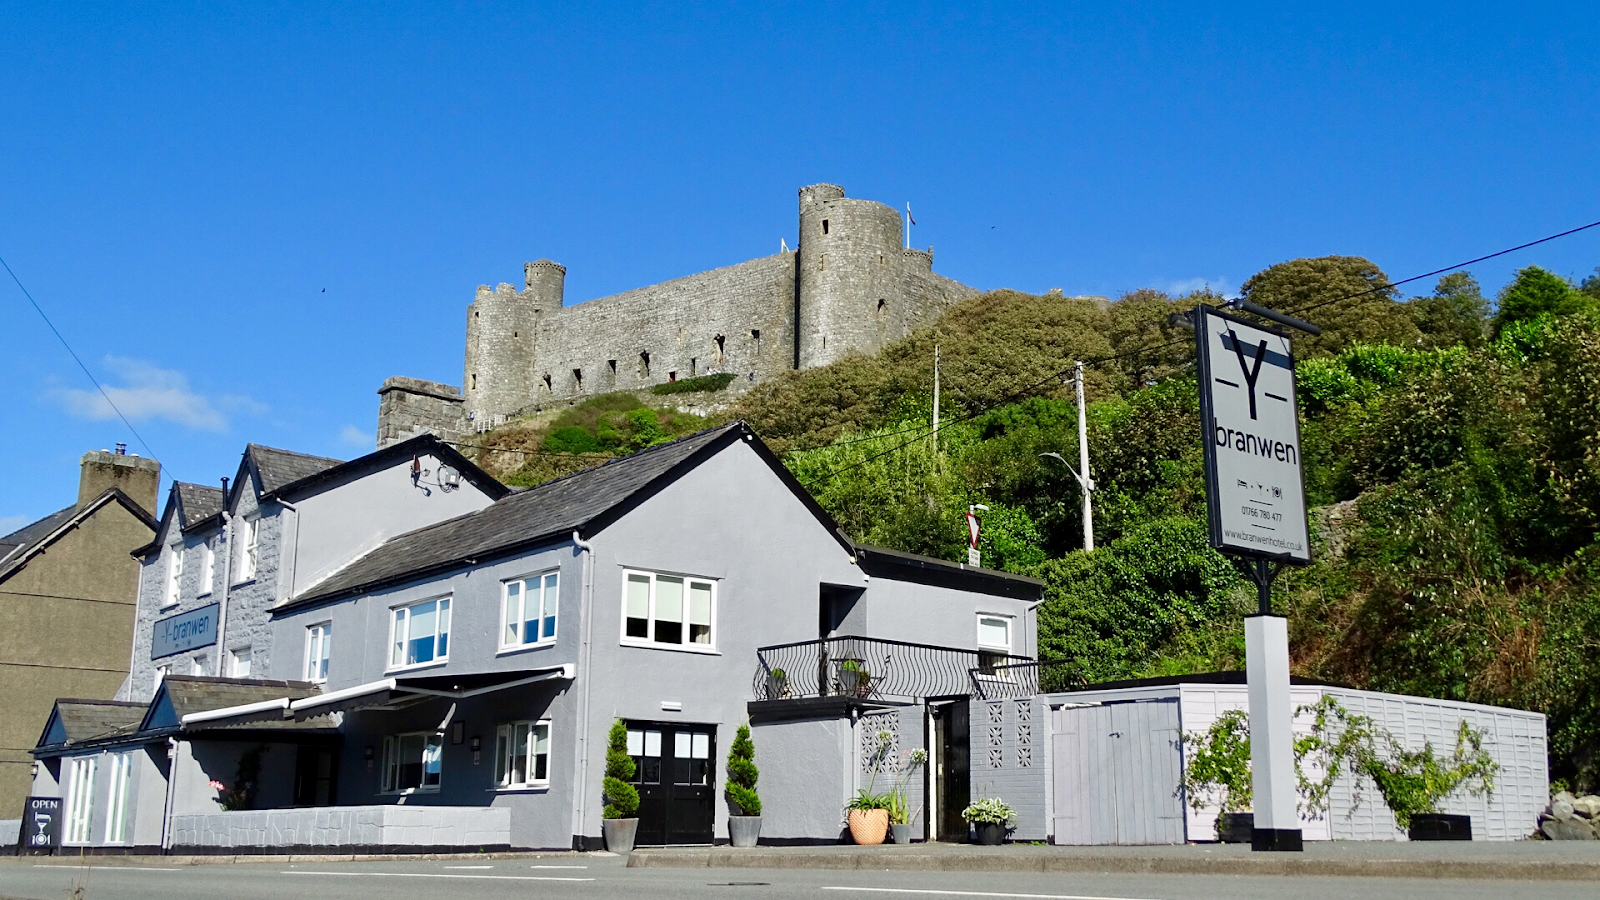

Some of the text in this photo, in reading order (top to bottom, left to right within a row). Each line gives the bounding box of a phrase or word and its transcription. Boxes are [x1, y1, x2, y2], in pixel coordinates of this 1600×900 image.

[1214, 417, 1297, 465] branwen
[1241, 506, 1282, 522] 01766 780 477
[1224, 529, 1303, 551] www.branwenhotel.co.uk
[32, 800, 58, 809] OPEN
